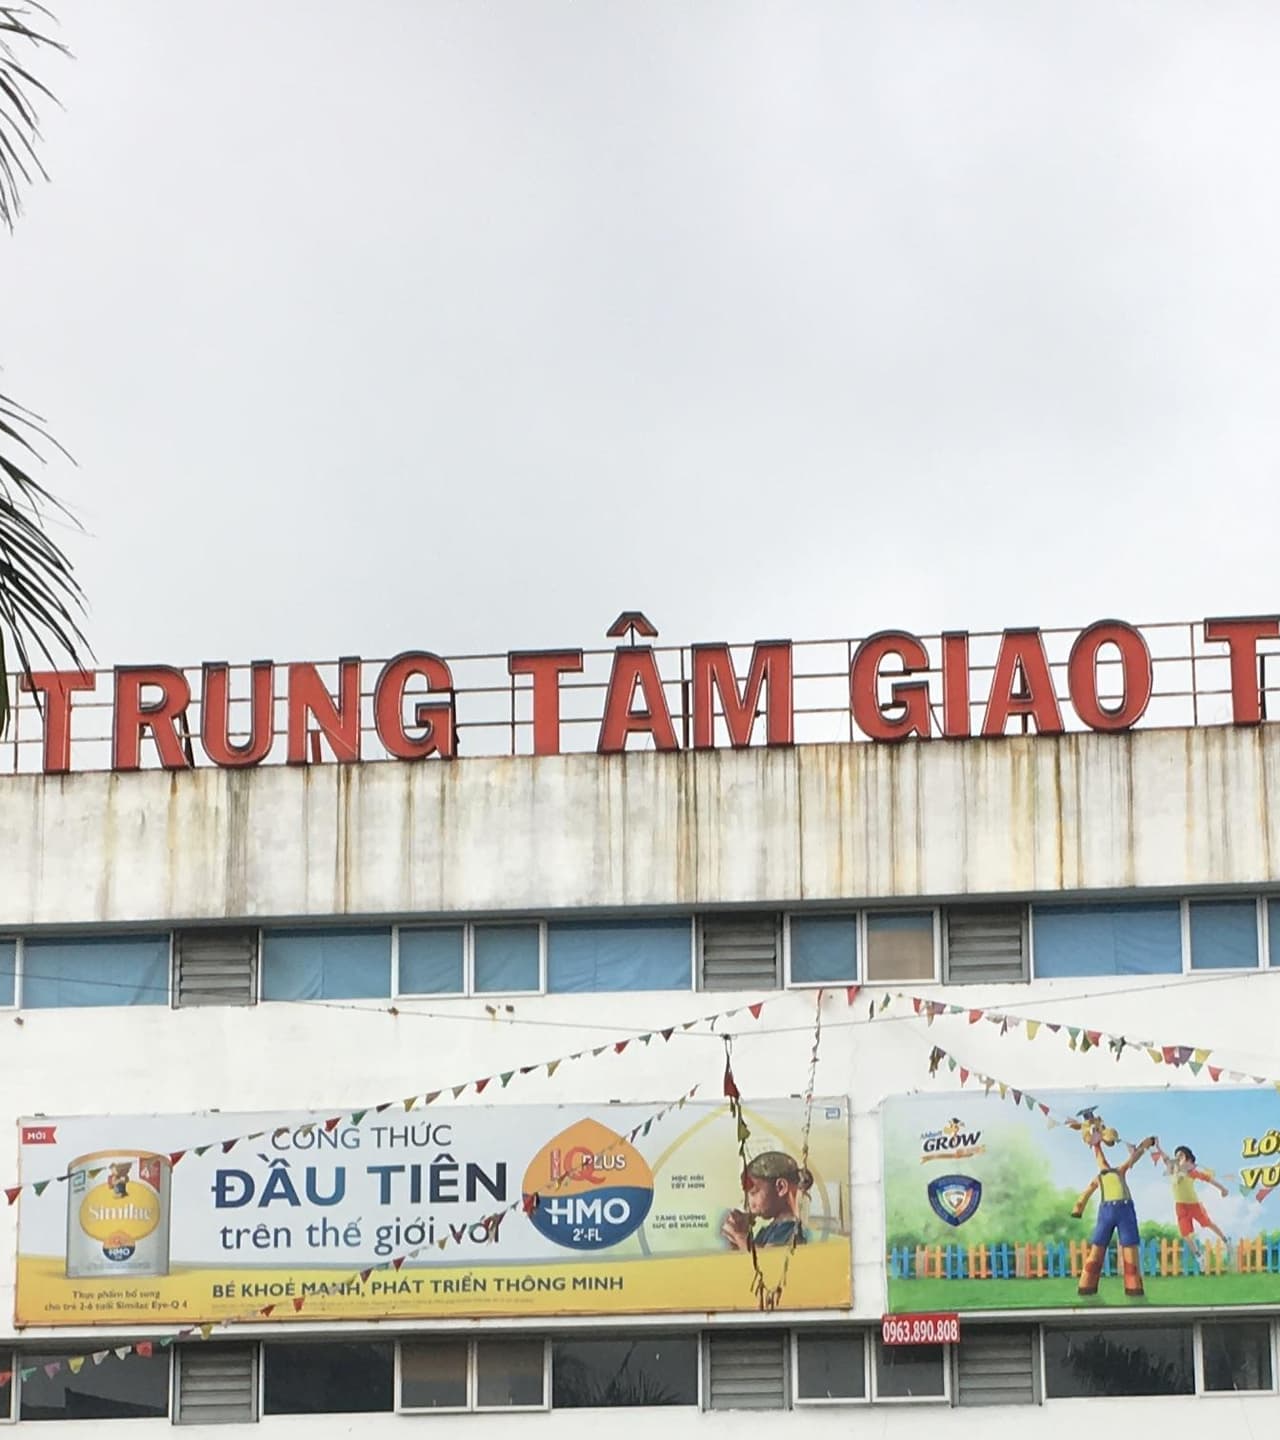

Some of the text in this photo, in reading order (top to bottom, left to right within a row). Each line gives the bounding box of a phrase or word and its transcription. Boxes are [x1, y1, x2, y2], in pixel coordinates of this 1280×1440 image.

[19, 650, 456, 773] TRUNG
[508, 611, 793, 755] TÂM
[850, 618, 1154, 743] GIAO
[370, 1121, 452, 1148] THỨC
[923, 1131, 982, 1152] GROW
[210, 1153, 507, 1209] ĐẦU TIÊN
[88, 1202, 152, 1221] Similac
[544, 1197, 631, 1225] HMO
[219, 1222, 292, 1249] trên
[306, 1216, 363, 1248] thế
[374, 1216, 435, 1257] giới
[212, 1279, 236, 1299] BÉ
[371, 1275, 425, 1296] PHÁT
[429, 1271, 487, 1294] TRIỂN
[493, 1274, 566, 1293] THÔNG
[572, 1275, 624, 1292] MINH
[882, 1319, 958, 1342] 0963.890.808
